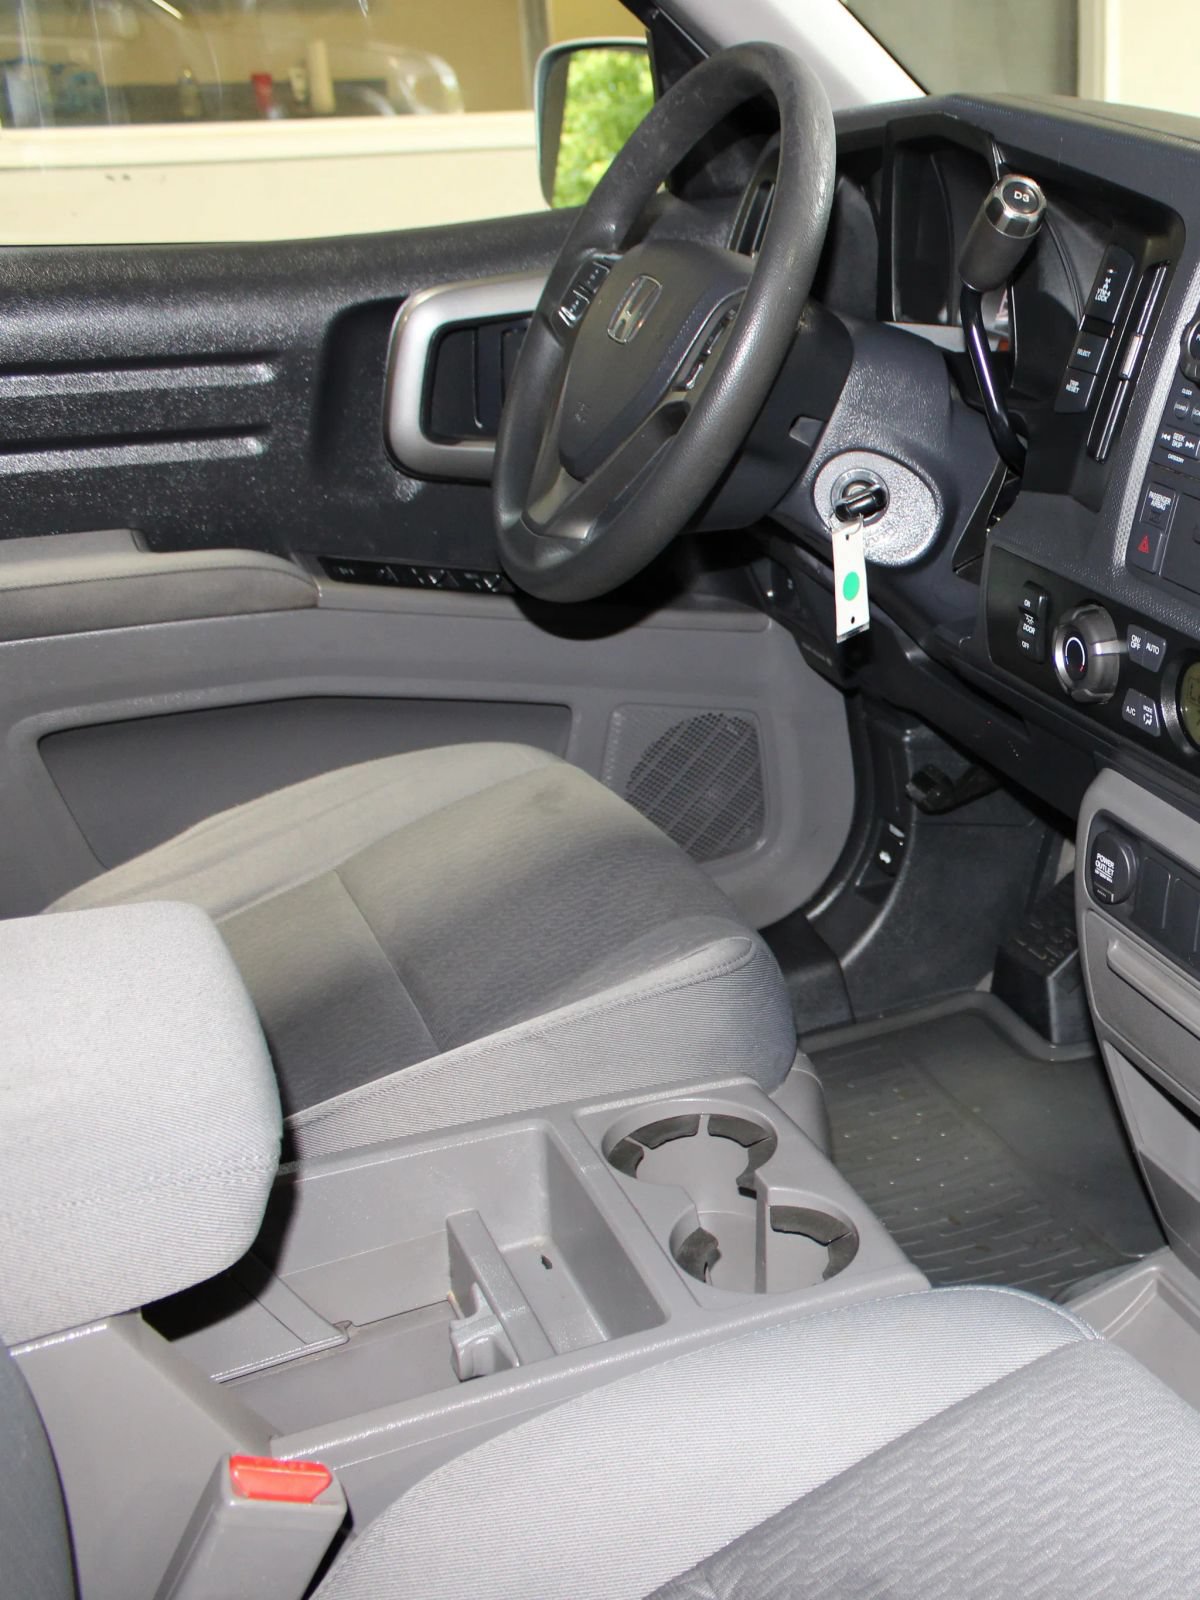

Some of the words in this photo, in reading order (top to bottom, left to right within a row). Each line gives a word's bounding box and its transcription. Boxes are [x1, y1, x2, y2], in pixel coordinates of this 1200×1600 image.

[1014, 190, 1030, 203] D3
[1023, 599, 1031, 608] ON
[1022, 623, 1036, 635] DOOR
[1021, 640, 1030, 650] OFF
[1130, 641, 1141, 650] OFF
[1145, 642, 1160, 655] AUTO
[1126, 705, 1136, 717] A/C
[1096, 852, 1115, 869] POWER
[1094, 860, 1115, 877] OUTLET
